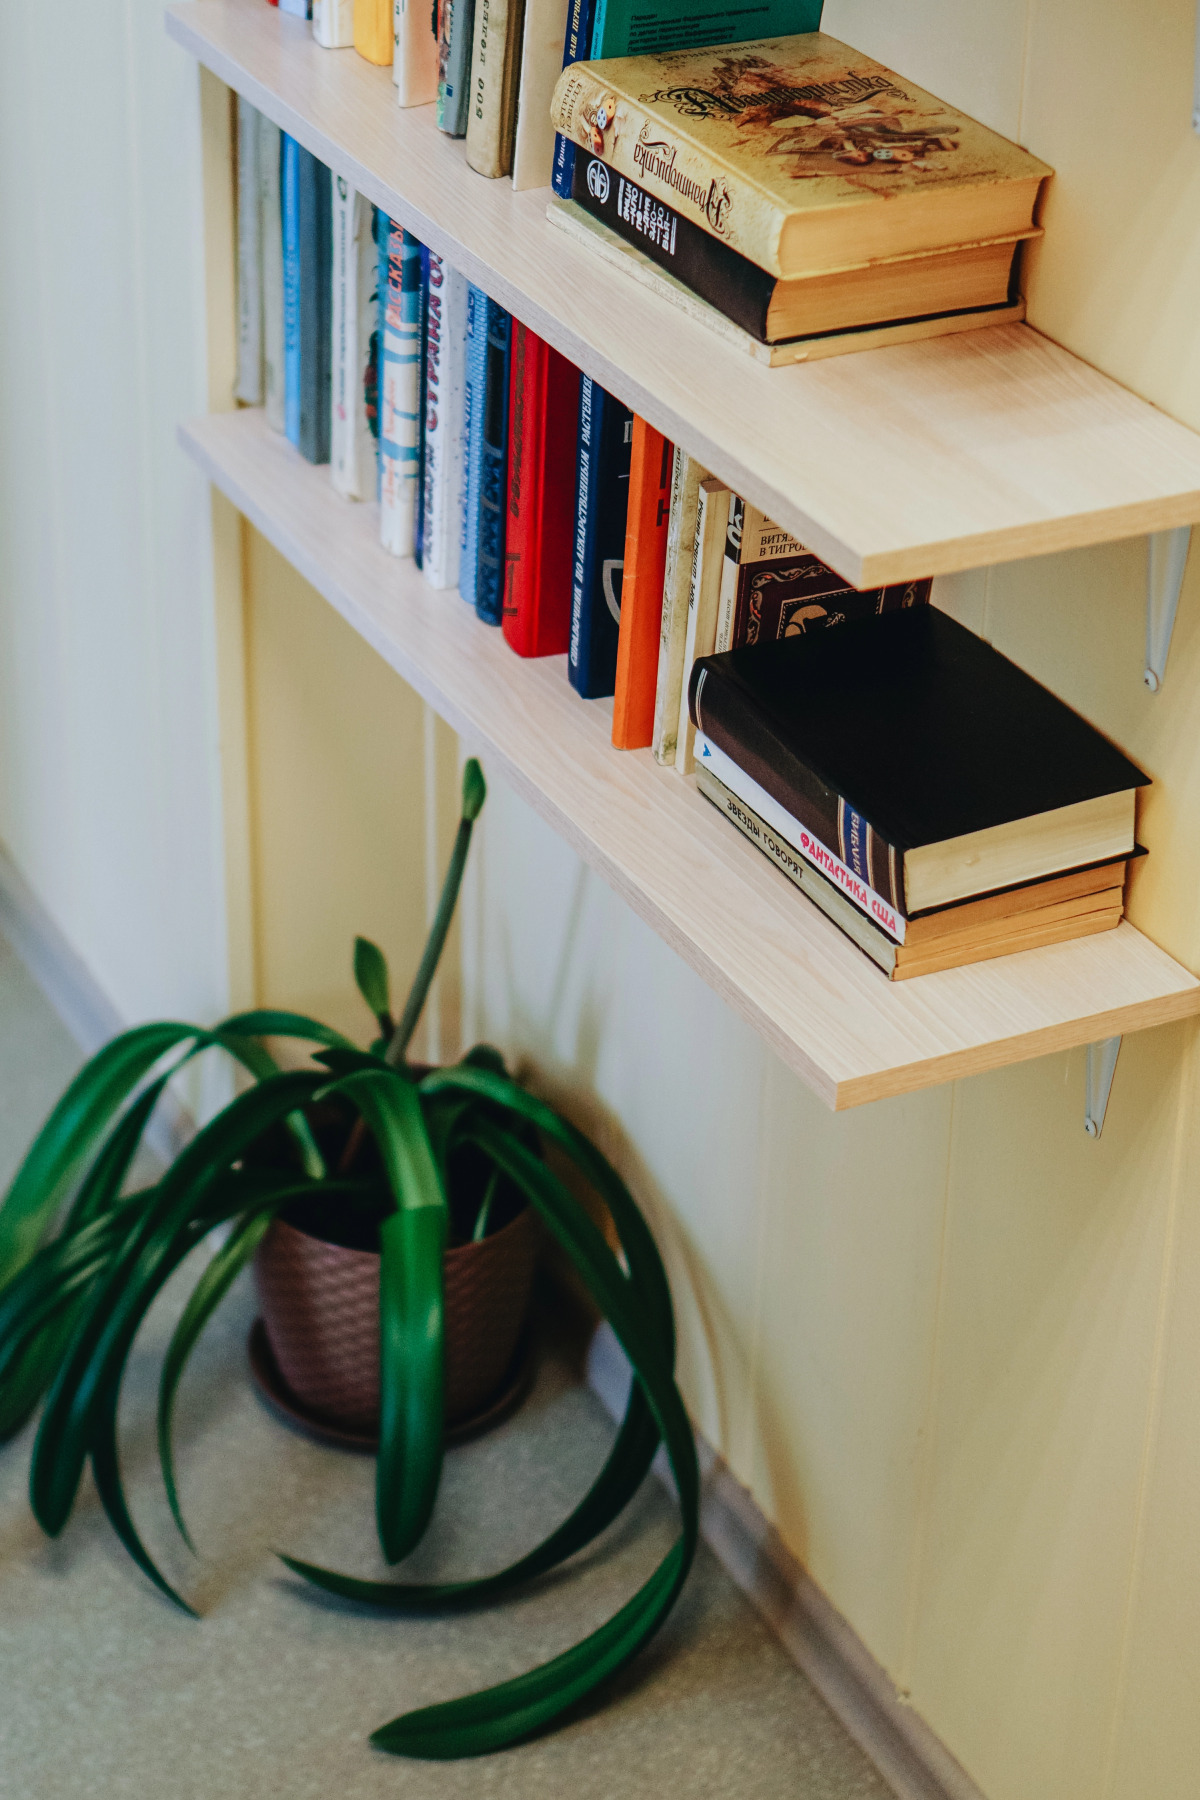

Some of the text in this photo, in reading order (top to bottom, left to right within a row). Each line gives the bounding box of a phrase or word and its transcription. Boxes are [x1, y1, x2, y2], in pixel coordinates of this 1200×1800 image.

[569, 36, 578, 59] ВАШ
[638, 70, 915, 121] Авантюристка
[633, 119, 736, 242] Авантюристка
[387, 218, 404, 331] РАССКАЗЫ
[575, 450, 590, 562] ЛЕКАРСТВЕННЫМ
[575, 563, 584, 585] ПО
[759, 547, 766, 557] В
[570, 586, 582, 668] СПРАВОЧНИК
[726, 798, 804, 879] ЗВЕЗДЫ ГОВОРЯТ
[850, 811, 862, 876] БИБЛИЯ
[799, 831, 897, 933] ФАНТАСТИКА США
